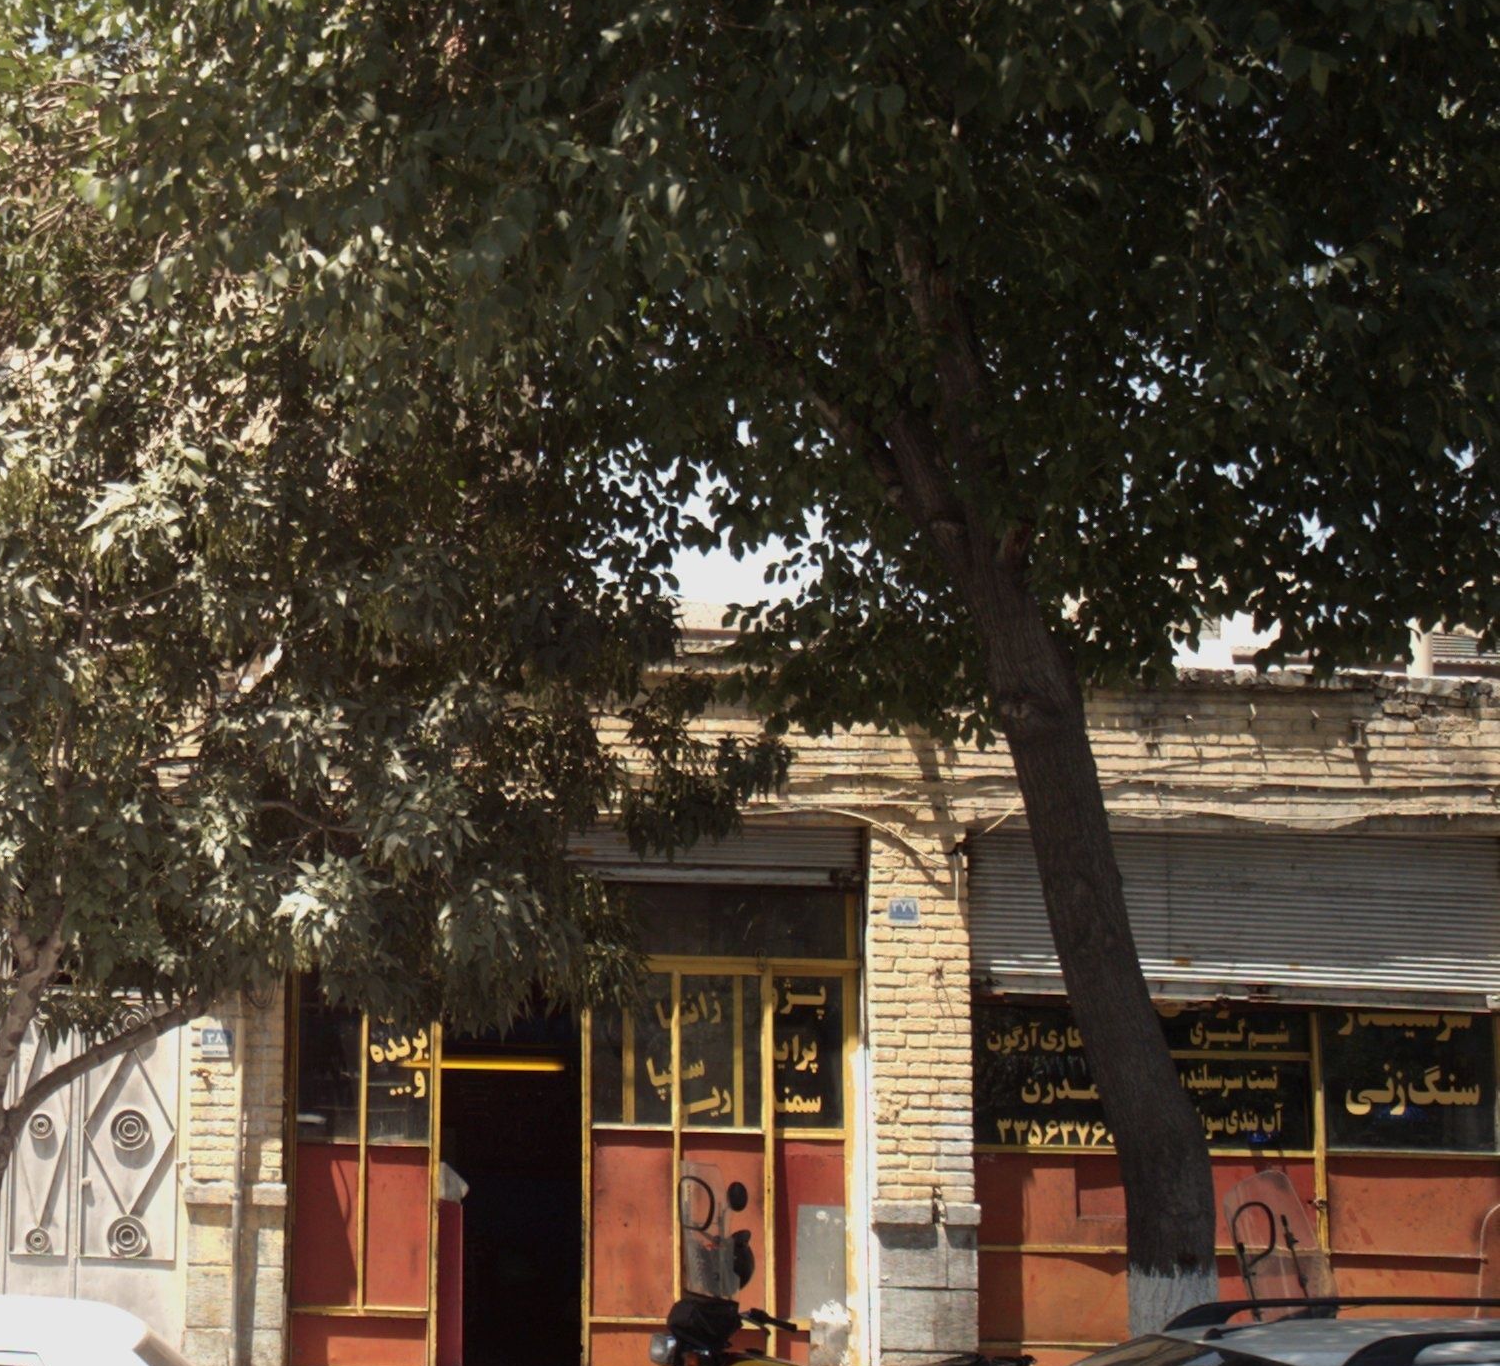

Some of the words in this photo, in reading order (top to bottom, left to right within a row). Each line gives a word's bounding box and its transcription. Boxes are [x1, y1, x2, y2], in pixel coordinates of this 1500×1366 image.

[772, 1035, 819, 1075] پرای
[986, 1021, 1040, 1055] آرگون
[773, 1086, 822, 1114] سمن
[1345, 1063, 1406, 1116] زنی
[1408, 1065, 1480, 1106] سنگ
